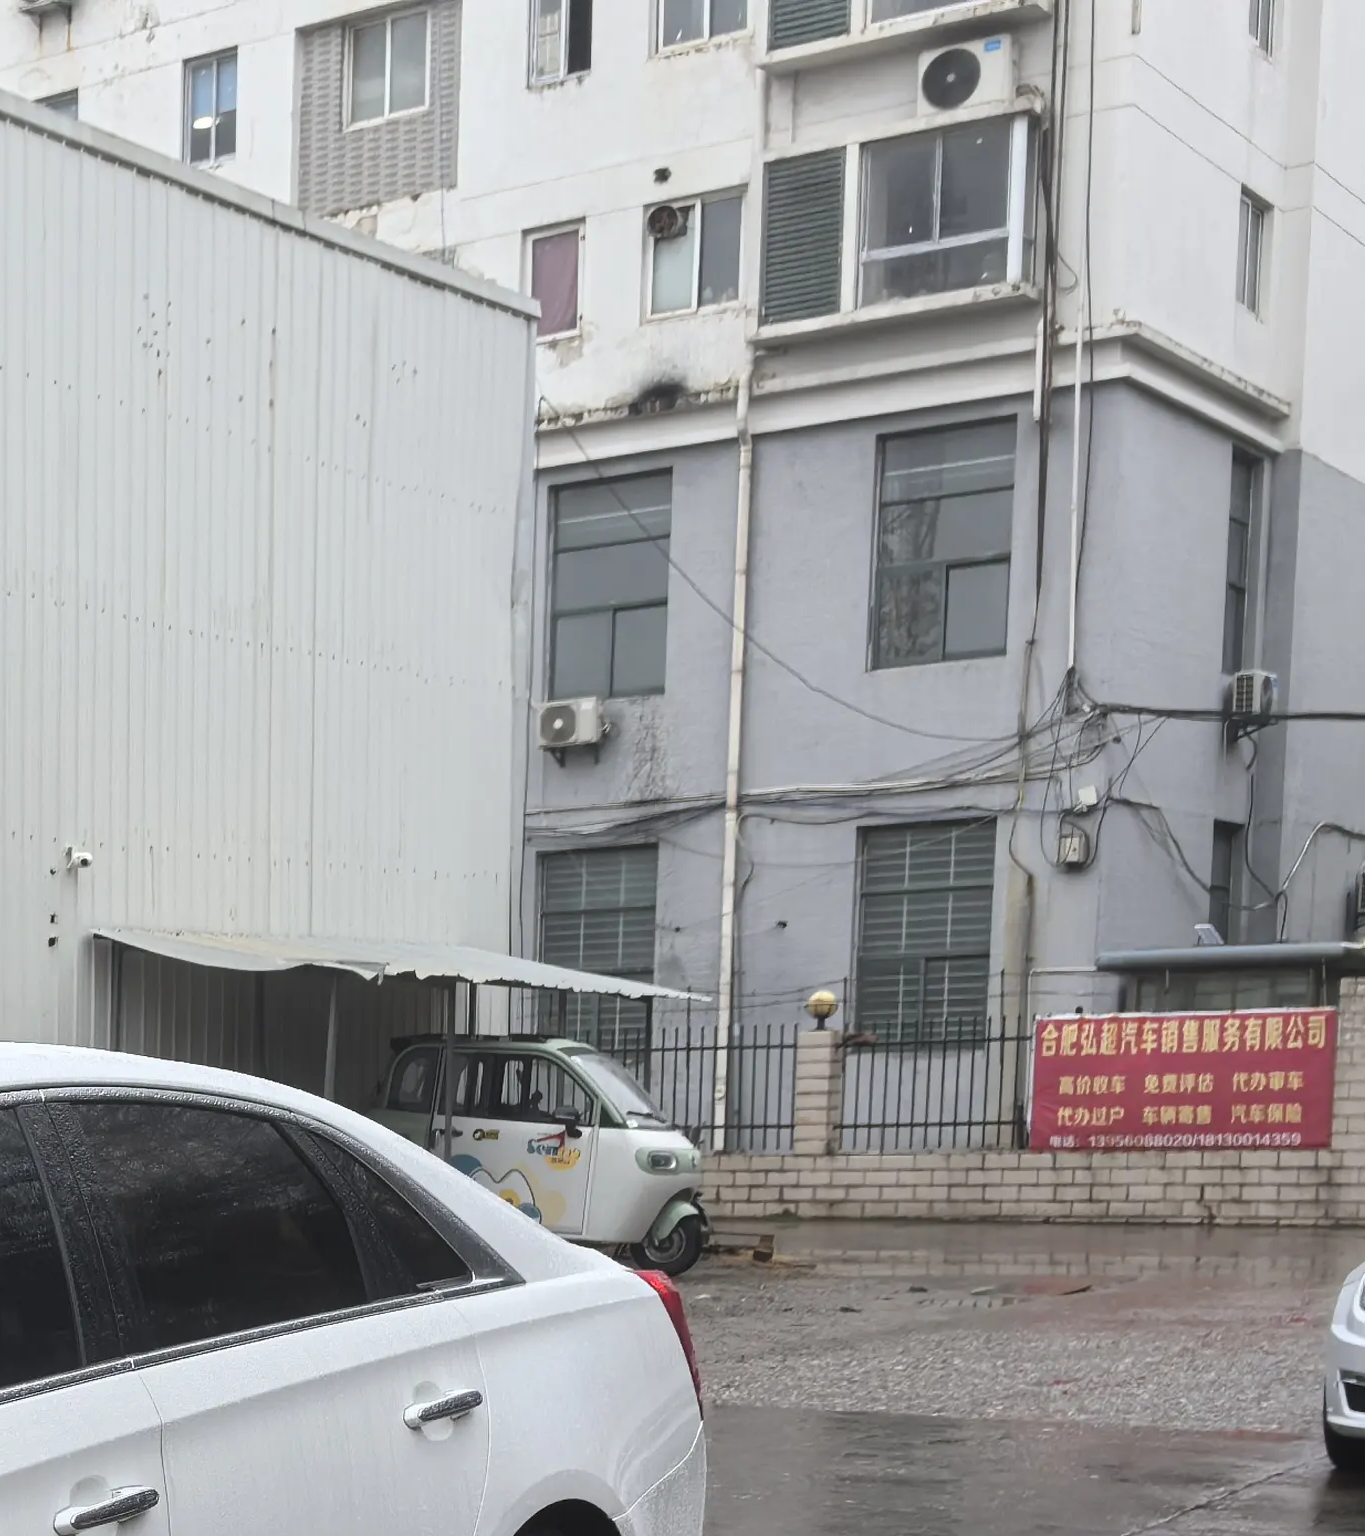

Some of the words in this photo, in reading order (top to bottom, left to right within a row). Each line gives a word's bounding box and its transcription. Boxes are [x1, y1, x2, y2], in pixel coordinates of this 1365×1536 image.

[1041, 1014, 1327, 1057] 合肥弘超汽车销售服务有限公司
[1058, 1074, 1126, 1096] 高价收车
[1143, 1073, 1215, 1094] 免费评估
[1232, 1071, 1304, 1093] 代办审车
[1057, 1106, 1125, 1127] 代办过户
[1142, 1105, 1213, 1125] 车辆寄售
[1230, 1102, 1303, 1124] 汽车保险
